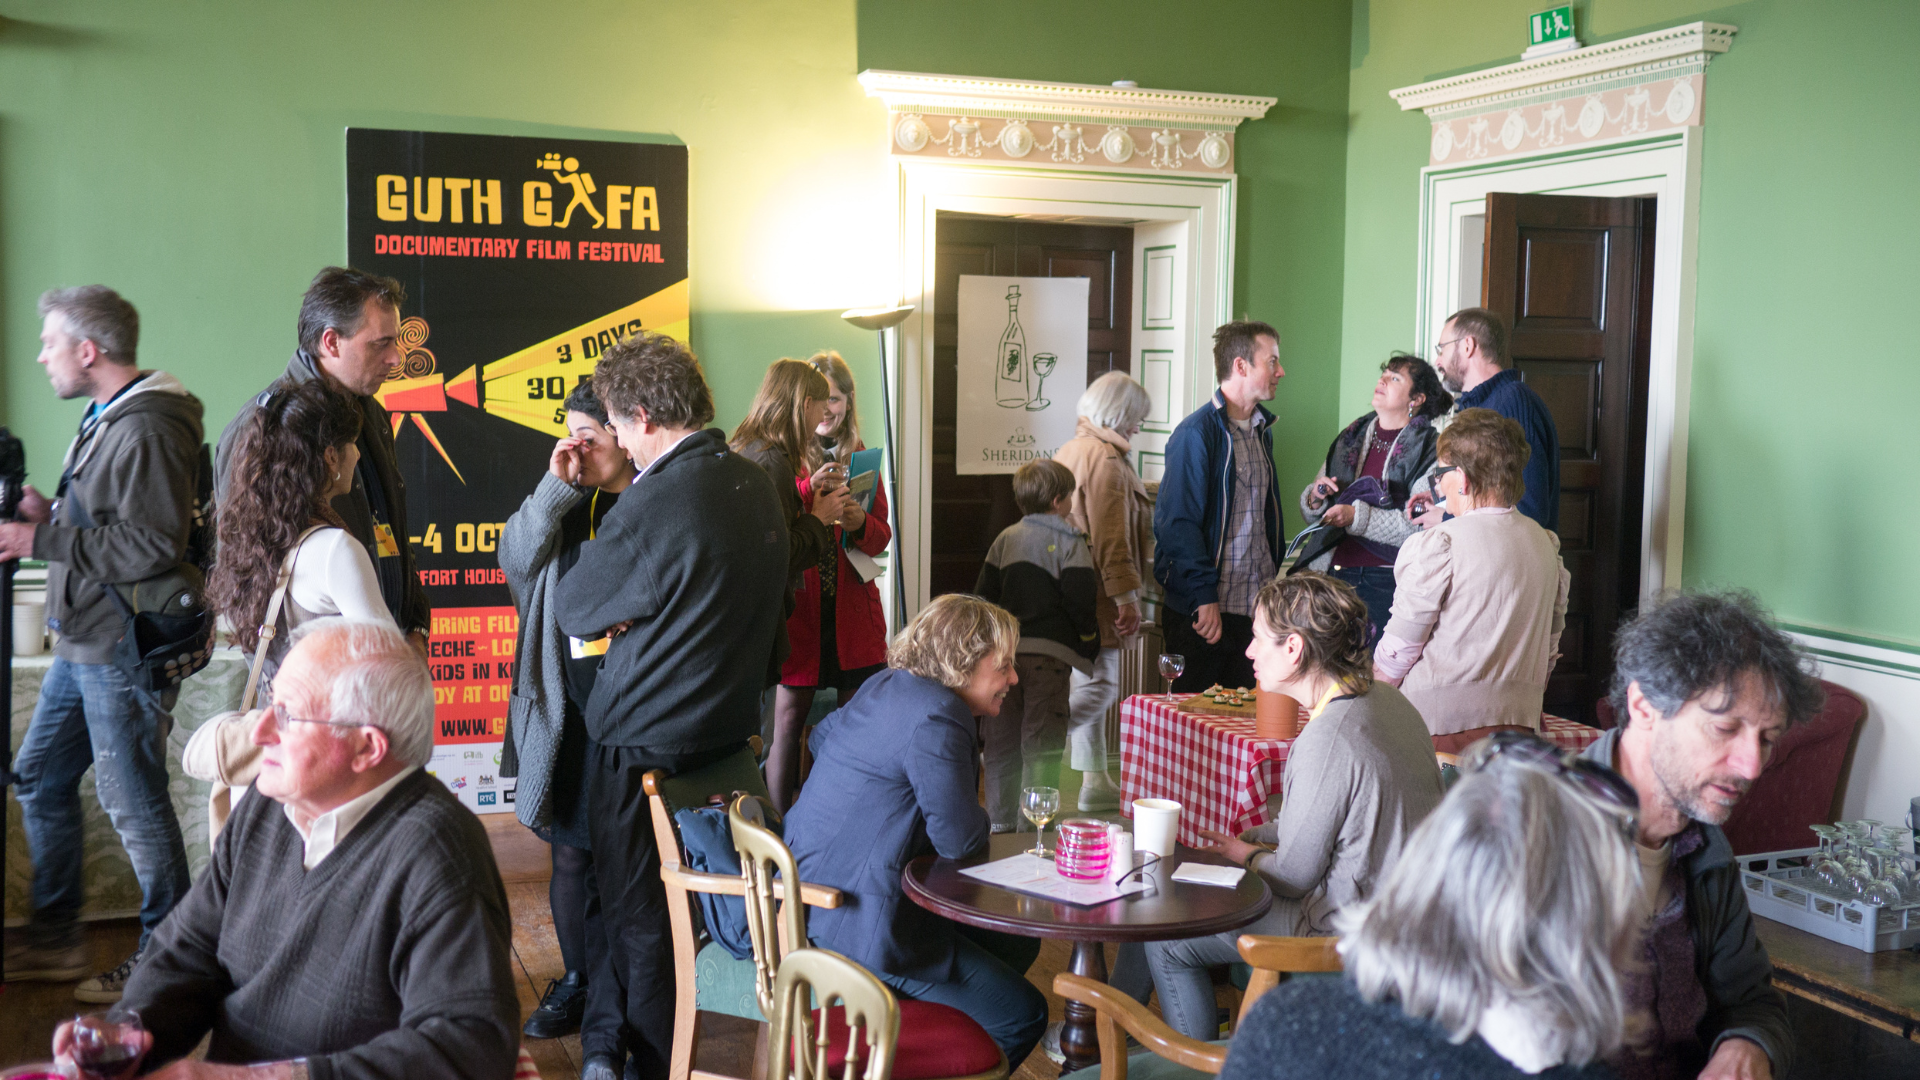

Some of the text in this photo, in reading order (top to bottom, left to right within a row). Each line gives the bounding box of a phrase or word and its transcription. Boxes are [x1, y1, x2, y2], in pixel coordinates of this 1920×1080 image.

[376, 174, 502, 225] GUTH
[375, 234, 519, 258] DOCUMENTARY
[556, 344, 572, 364] 3
[527, 376, 565, 400] 30
[982, 448, 1060, 461] SHERIDAN
[416, 568, 508, 586] FORT HOUS
[492, 639, 517, 656] LO
[463, 685, 482, 703] AT
